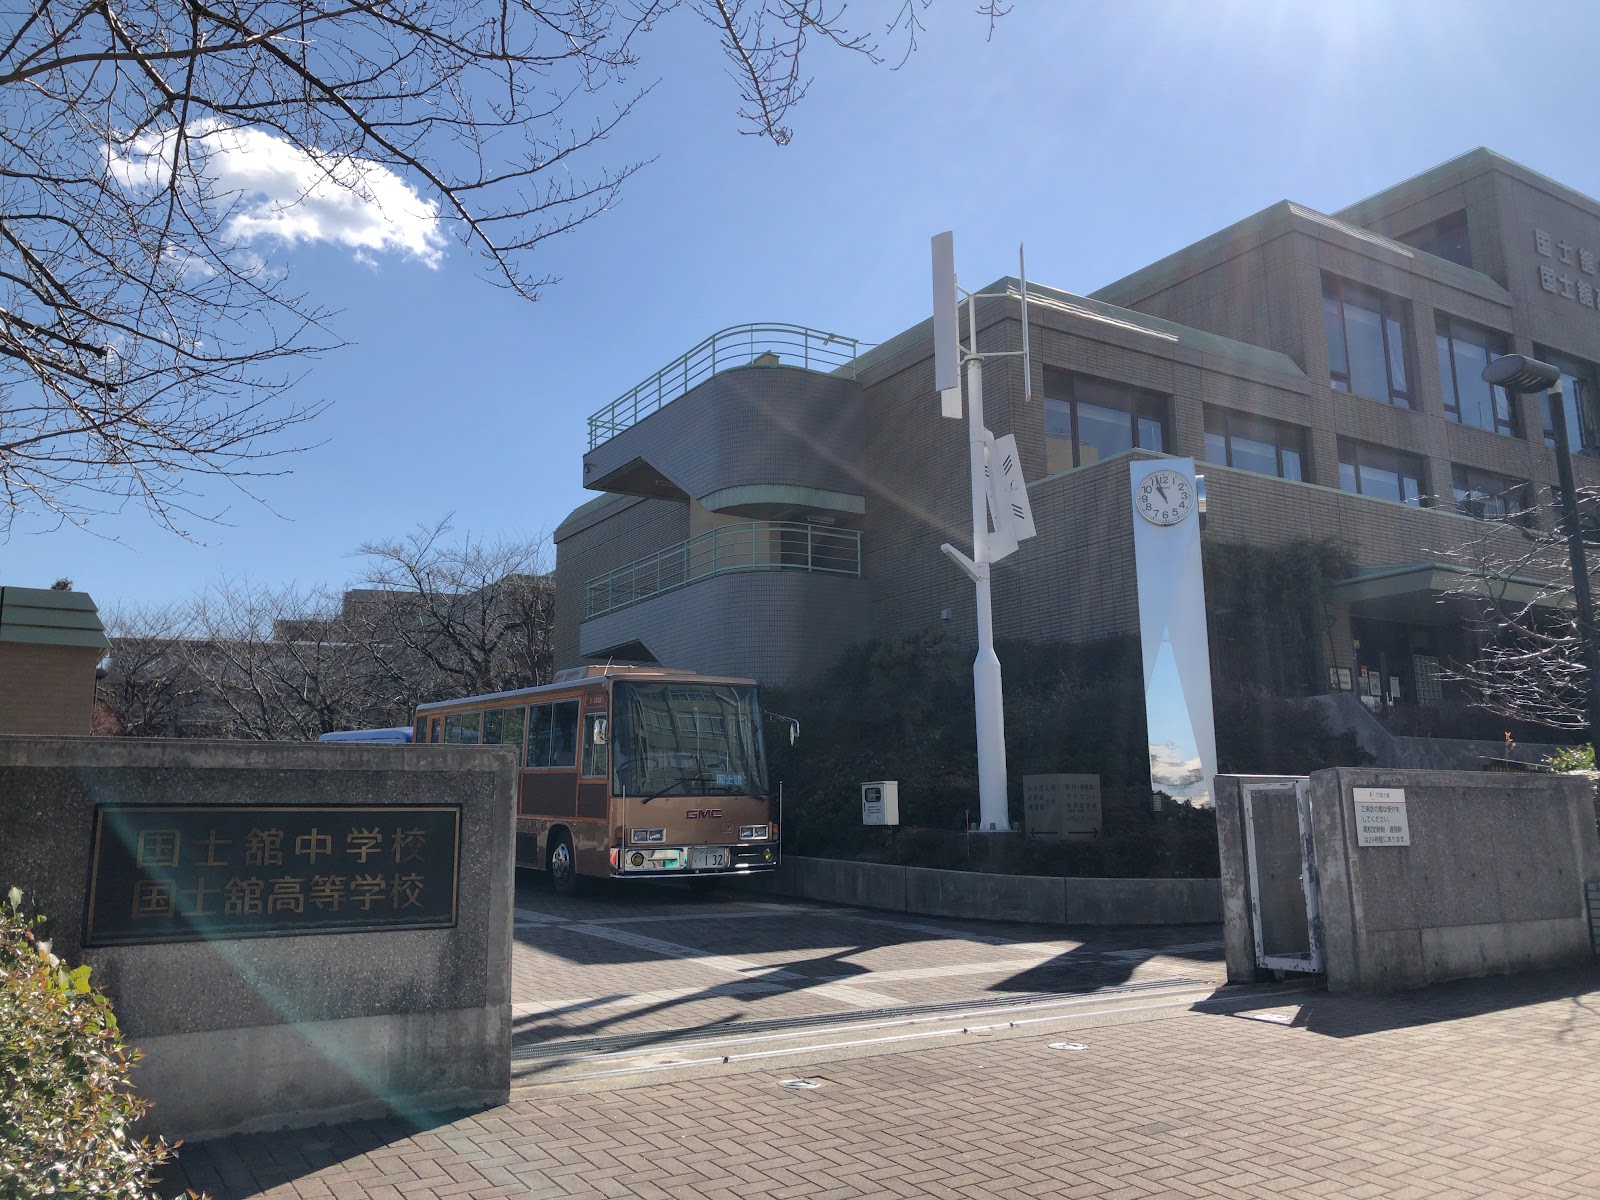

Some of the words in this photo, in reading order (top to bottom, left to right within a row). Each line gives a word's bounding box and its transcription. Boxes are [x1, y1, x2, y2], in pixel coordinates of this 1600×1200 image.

[1160, 475, 1169, 484] 12
[1143, 485, 1152, 494] 10
[1178, 483, 1184, 491] 2
[1141, 495, 1148, 503] 9
[1181, 492, 1188, 500] 3
[1145, 502, 1152, 511] 8
[1178, 501, 1186, 509] 4
[1153, 509, 1160, 517] 7
[1162, 511, 1169, 519] 6
[1172, 508, 1178, 516] 5
[686, 808, 722, 819] GMC
[136, 827, 428, 869] 国士舘中学校
[131, 872, 425, 920] 国士舘高等学校
